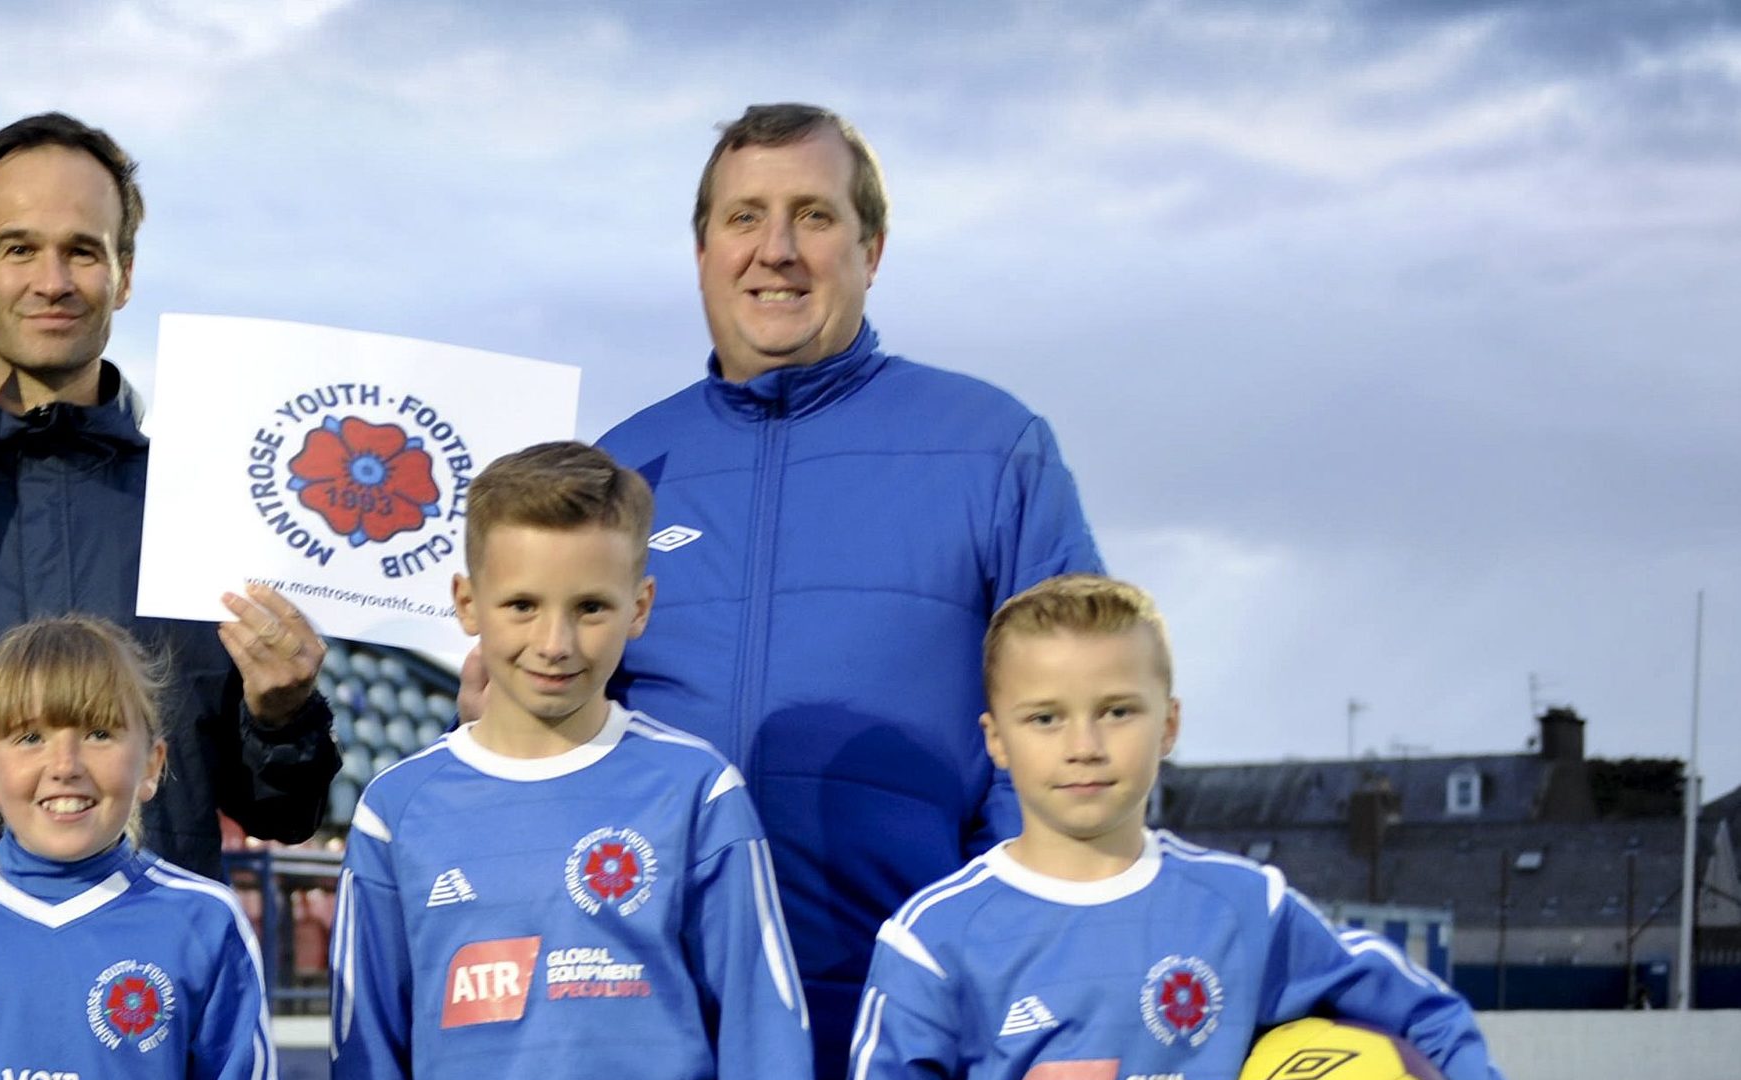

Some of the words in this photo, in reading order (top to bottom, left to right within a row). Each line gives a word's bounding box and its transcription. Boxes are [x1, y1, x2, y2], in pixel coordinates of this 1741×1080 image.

[275, 383, 380, 424] YOUTH
[248, 428, 335, 566] MONTROSE
[381, 534, 453, 578] CLUB
[546, 947, 614, 967] GLOBAL
[452, 961, 521, 1004] ATR
